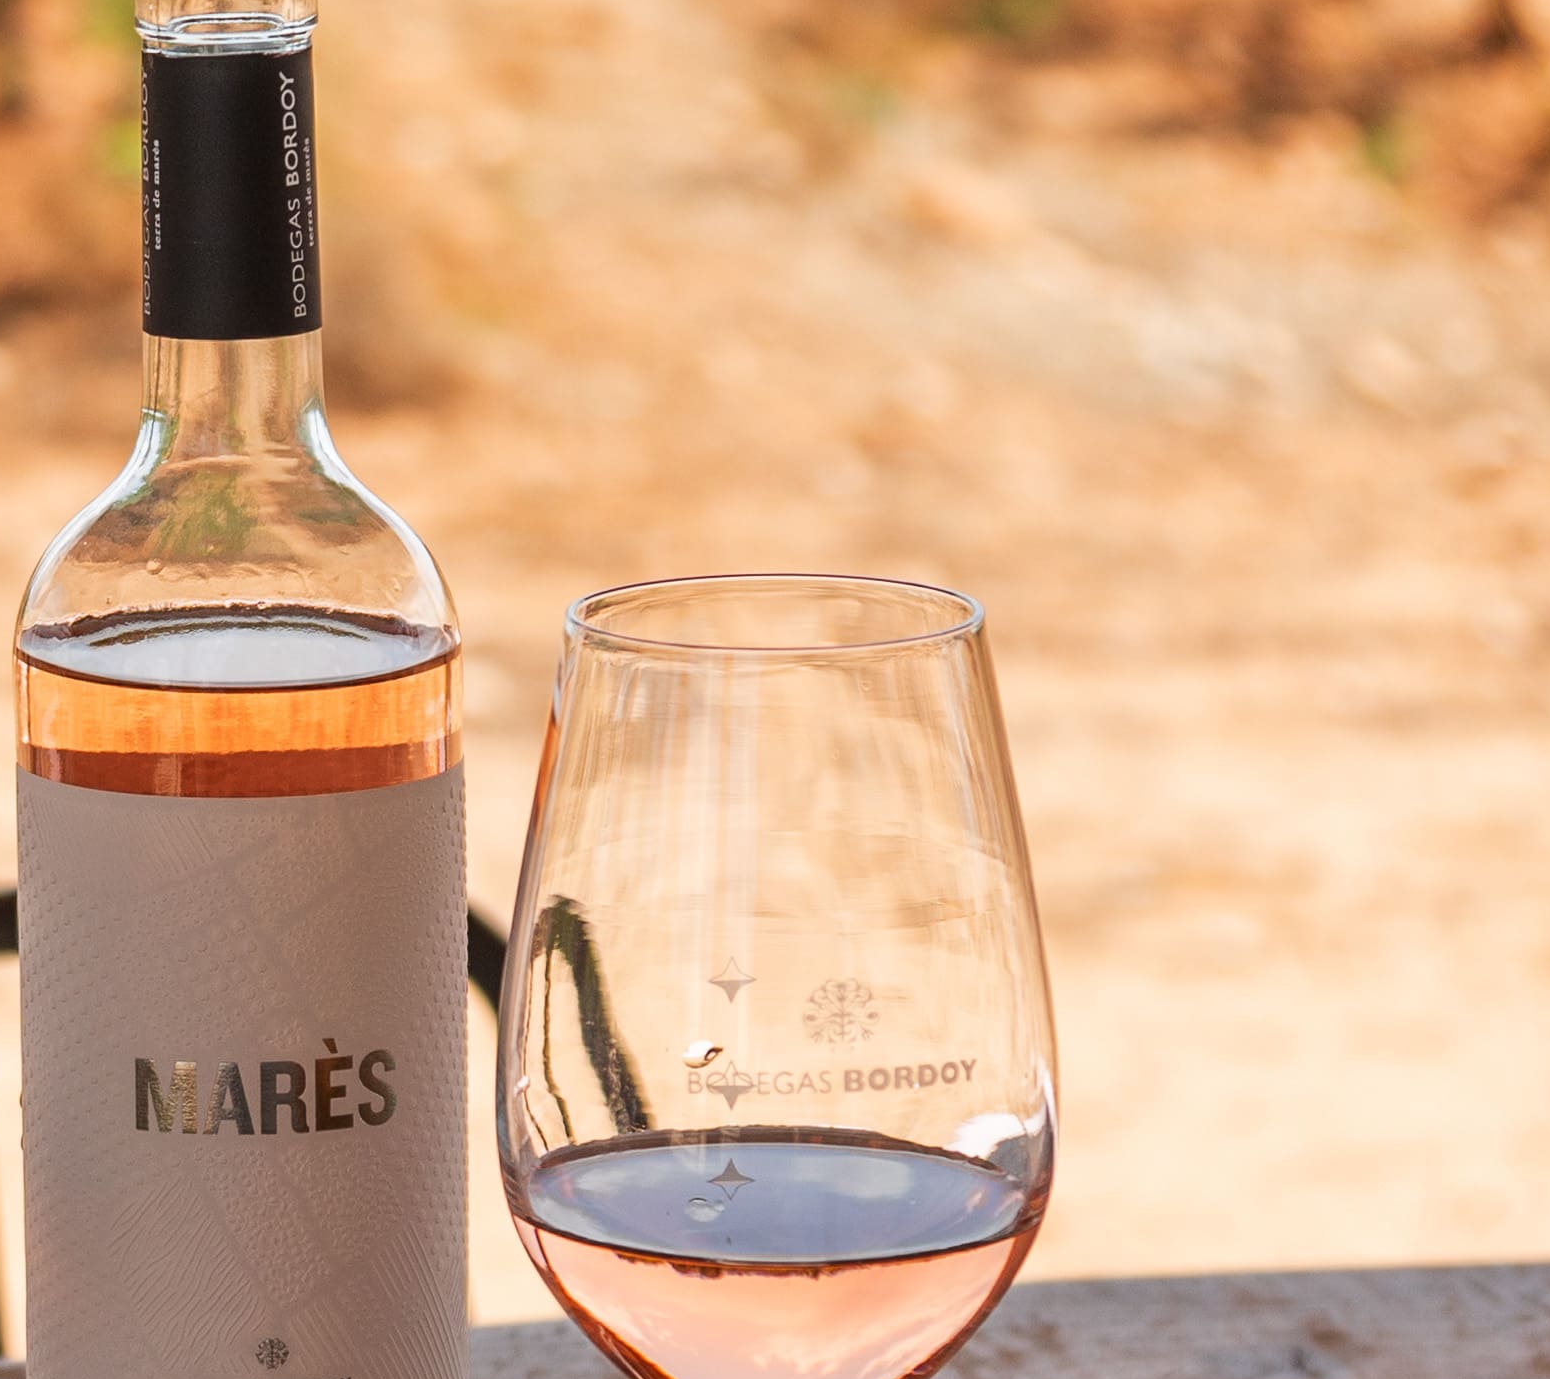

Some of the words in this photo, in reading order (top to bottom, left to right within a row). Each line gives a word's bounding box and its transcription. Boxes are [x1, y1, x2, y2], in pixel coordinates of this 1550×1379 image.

[278, 71, 300, 187] BORDOY
[152, 189, 161, 209] de
[305, 186, 313, 206] de
[154, 213, 162, 250] terra
[287, 198, 307, 318] BODEGAS
[134, 1037, 397, 1136] MARÈS
[687, 1069, 833, 1096] BODEGAS
[842, 1058, 978, 1093] BORDOY
